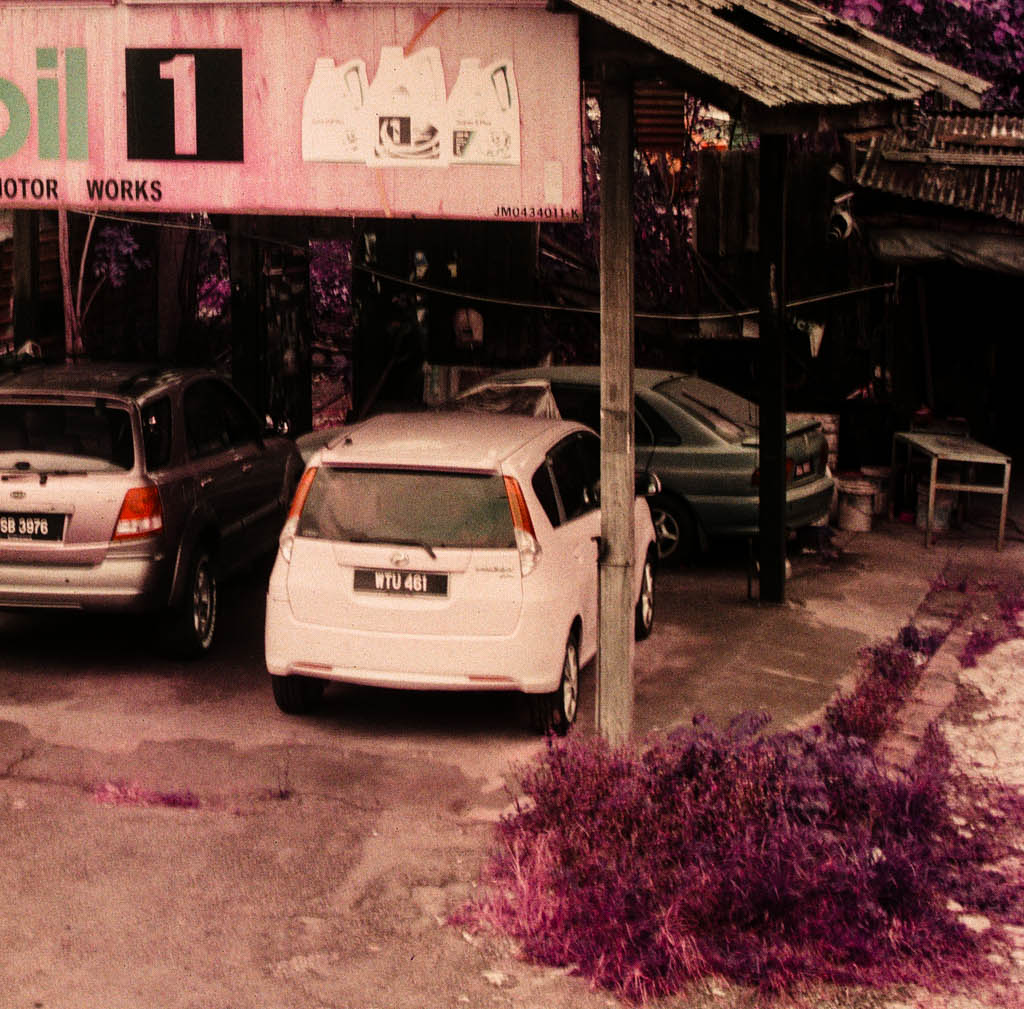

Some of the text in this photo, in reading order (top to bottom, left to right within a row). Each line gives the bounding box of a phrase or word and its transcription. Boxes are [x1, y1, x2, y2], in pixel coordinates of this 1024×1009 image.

[159, 54, 198, 156] 1
[86, 179, 163, 202] WORKS
[18, 517, 49, 536] 3976
[375, 571, 402, 591] WTU
